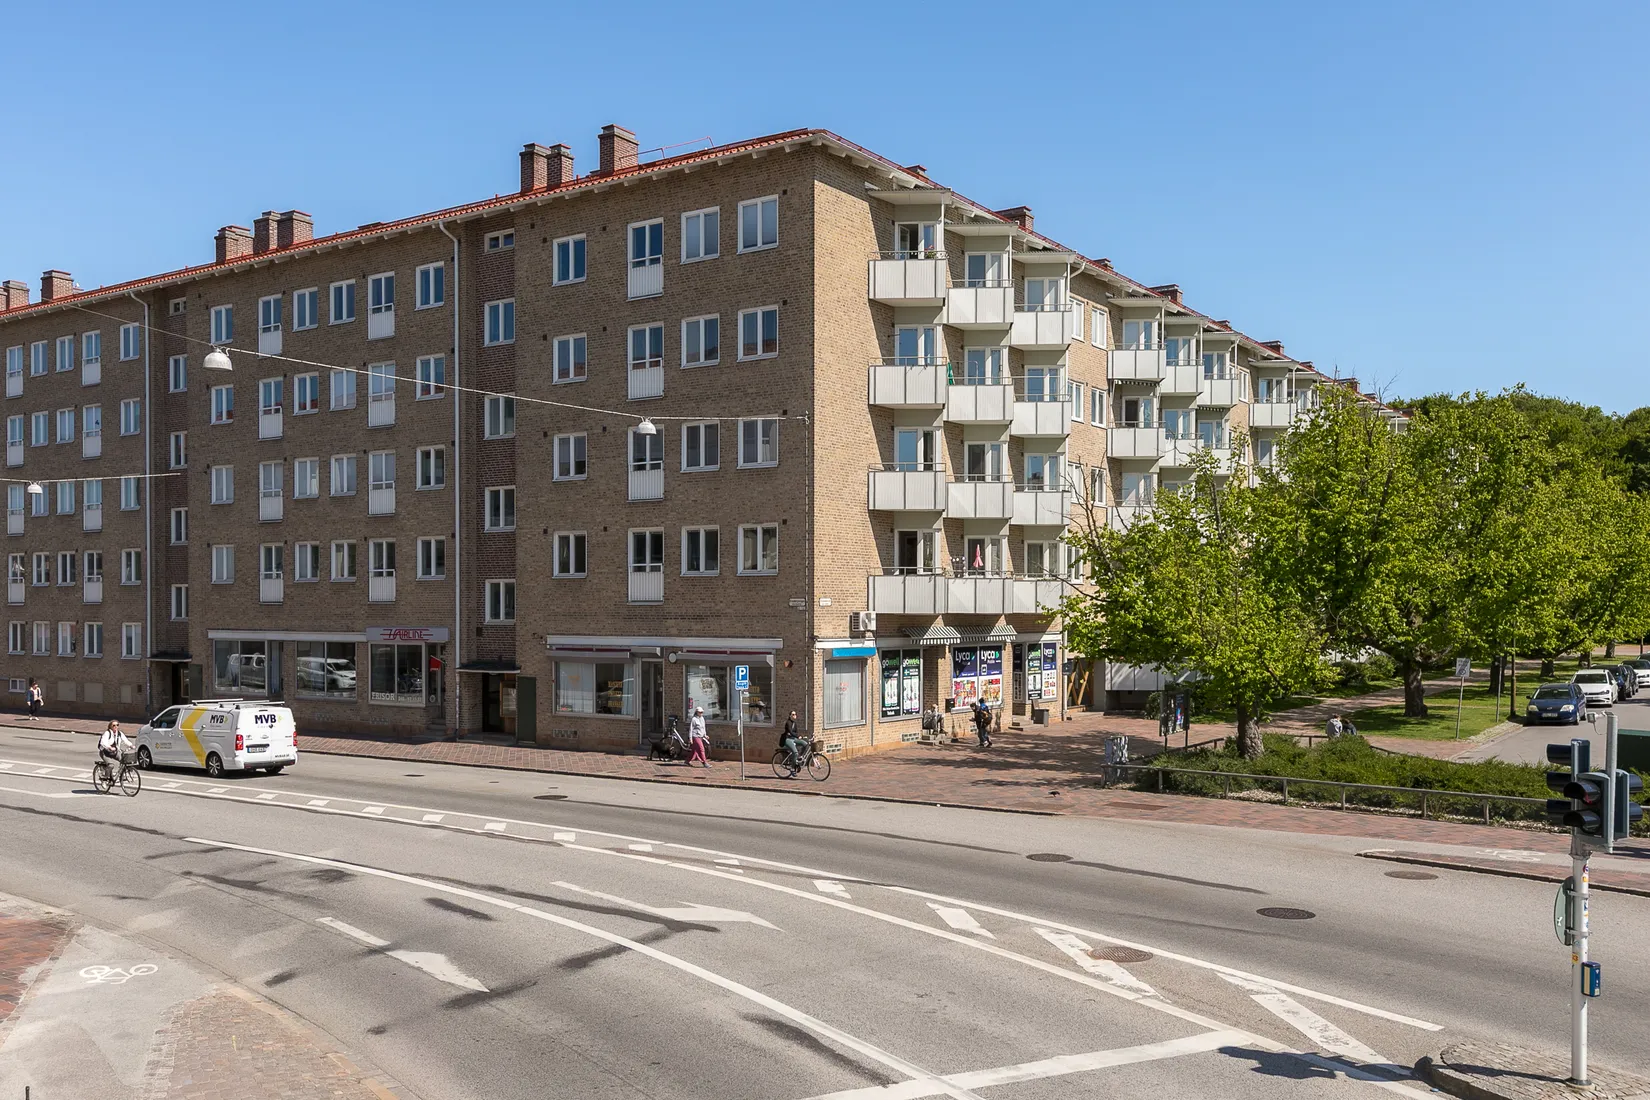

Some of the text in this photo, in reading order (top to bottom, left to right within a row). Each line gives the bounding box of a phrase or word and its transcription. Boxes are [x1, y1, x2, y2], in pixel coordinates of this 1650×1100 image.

[382, 629, 430, 641] HAIRLINE
[955, 650, 970, 662] Lyca
[981, 650, 995, 661] Lyca
[738, 667, 747, 680] P
[209, 714, 225, 724] MVB
[254, 714, 277, 724] MVB
